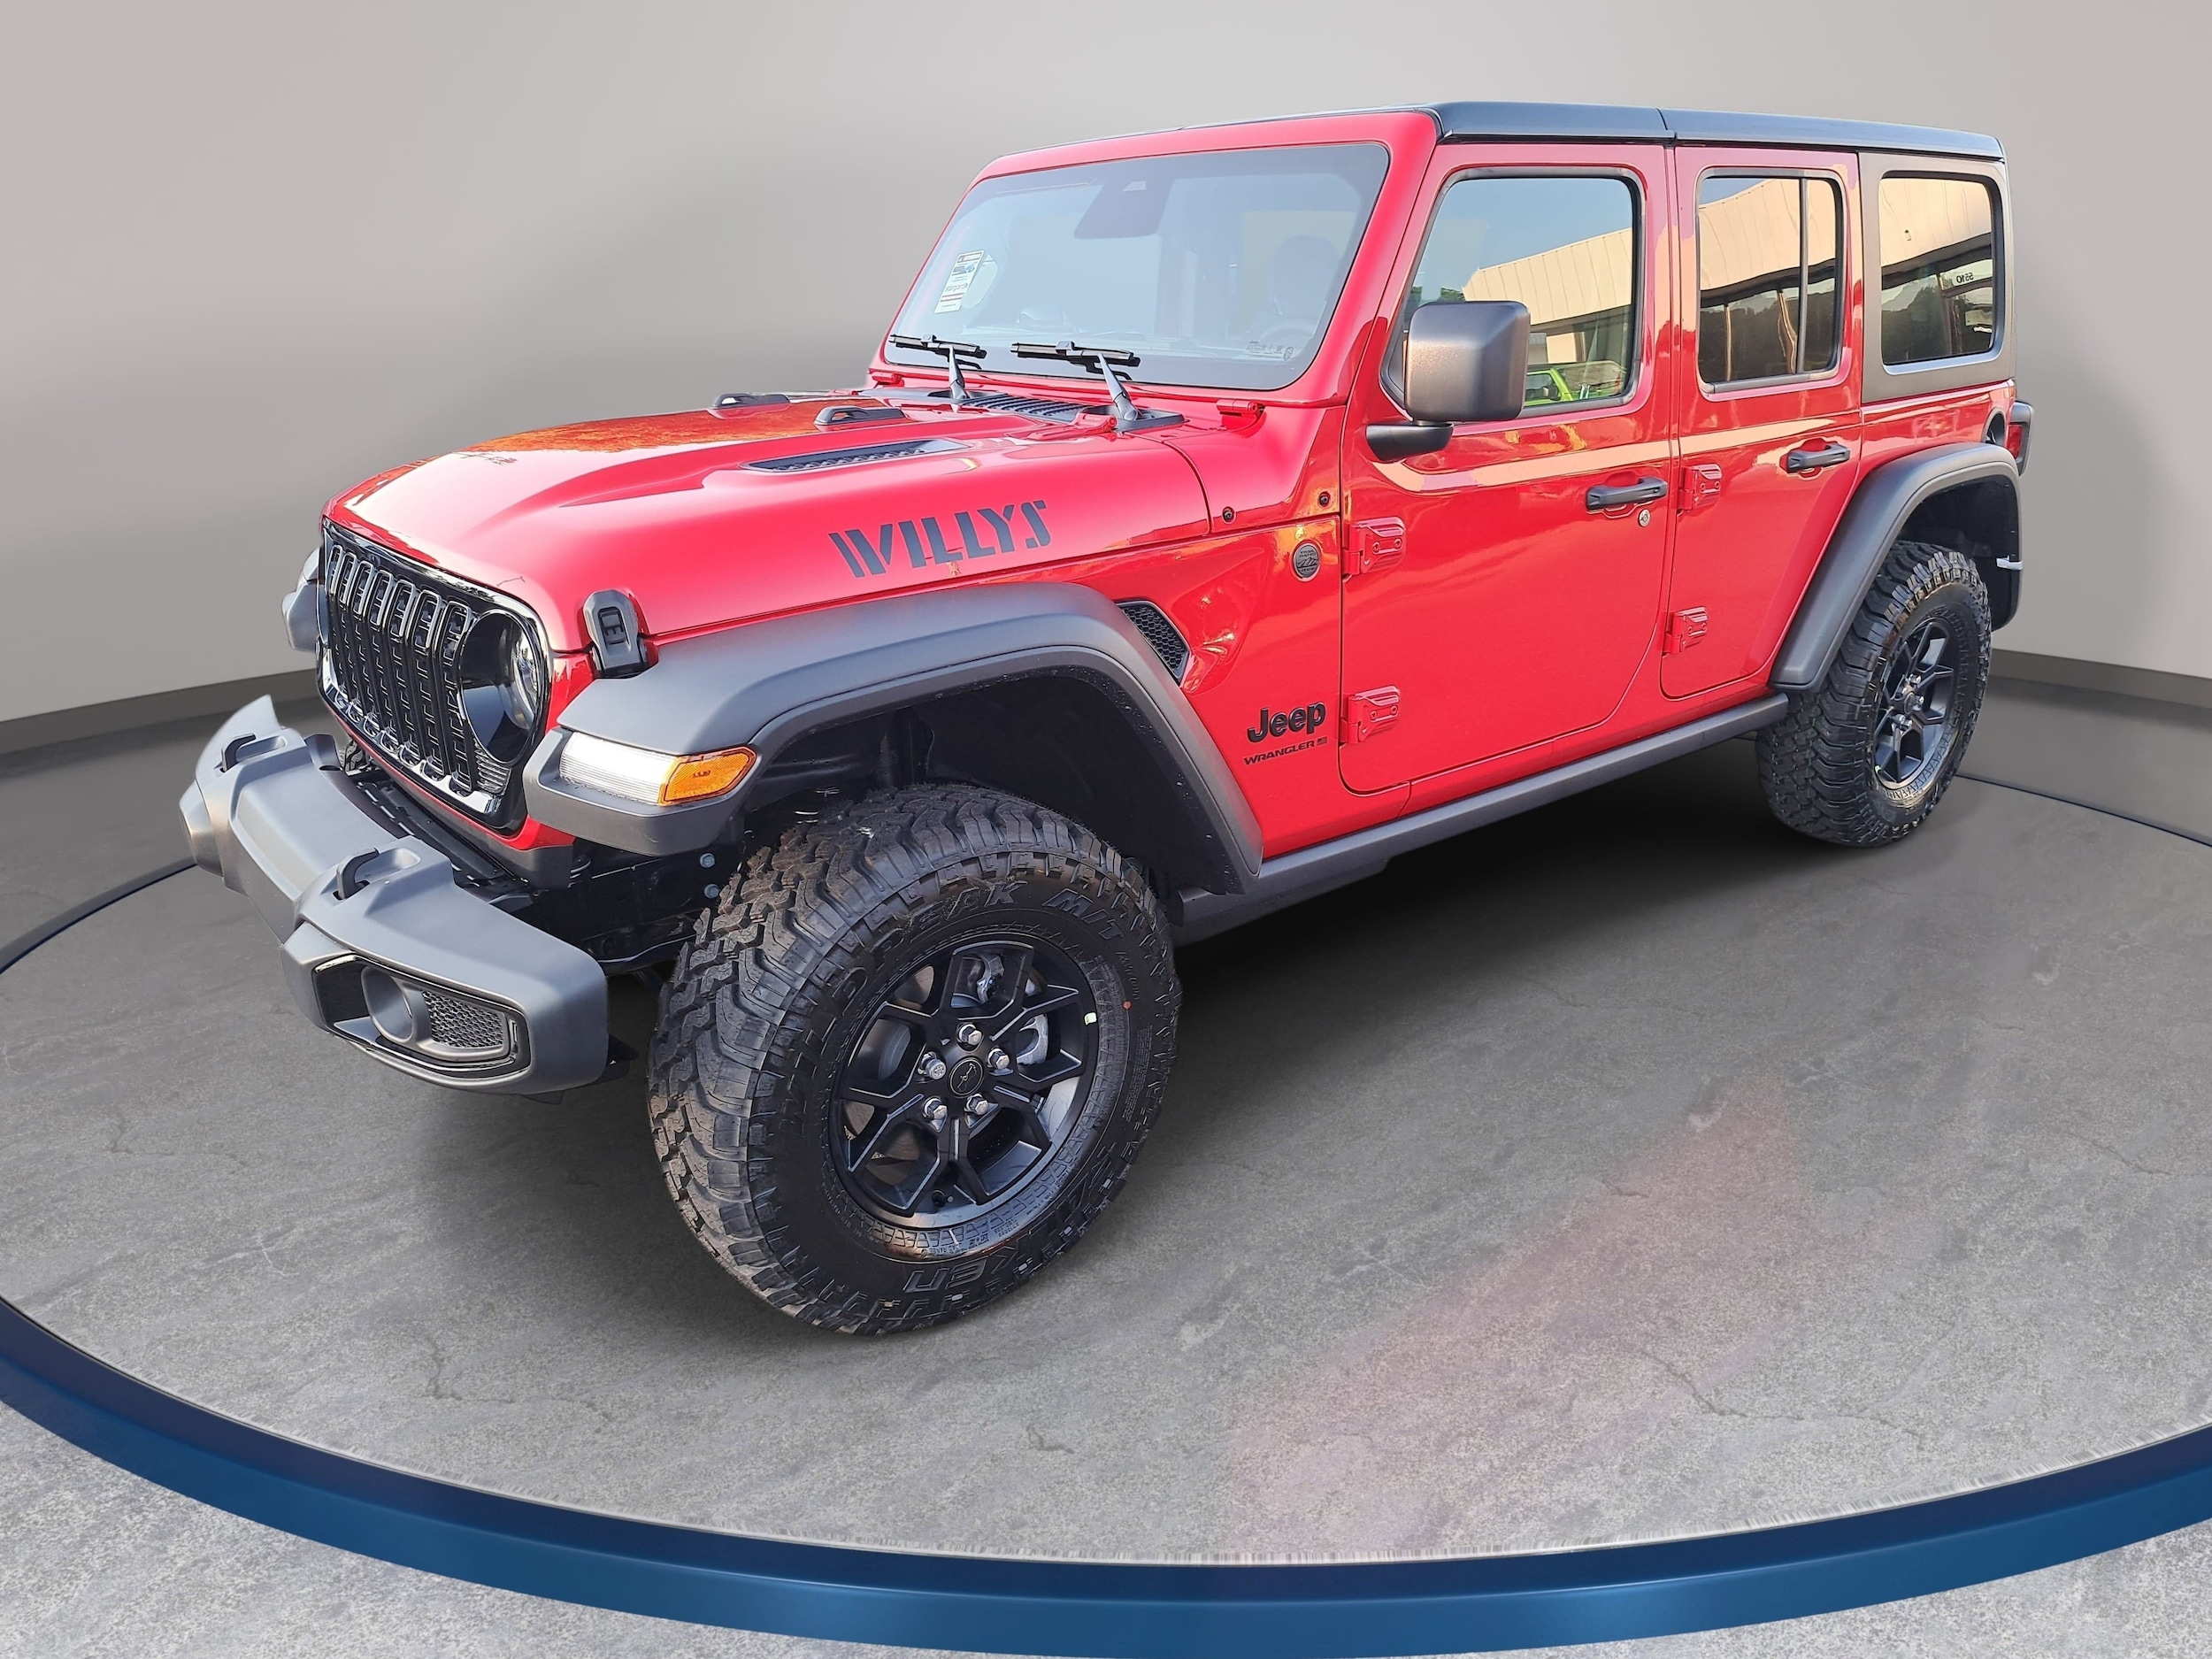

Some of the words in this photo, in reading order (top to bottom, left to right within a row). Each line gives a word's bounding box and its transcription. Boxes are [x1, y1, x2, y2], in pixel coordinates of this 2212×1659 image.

[828, 500, 1052, 578] WILLYS
[1247, 702, 1326, 742] Jeep
[1243, 740, 1316, 765] WRANGLER
[1041, 887, 1126, 940] M/T
